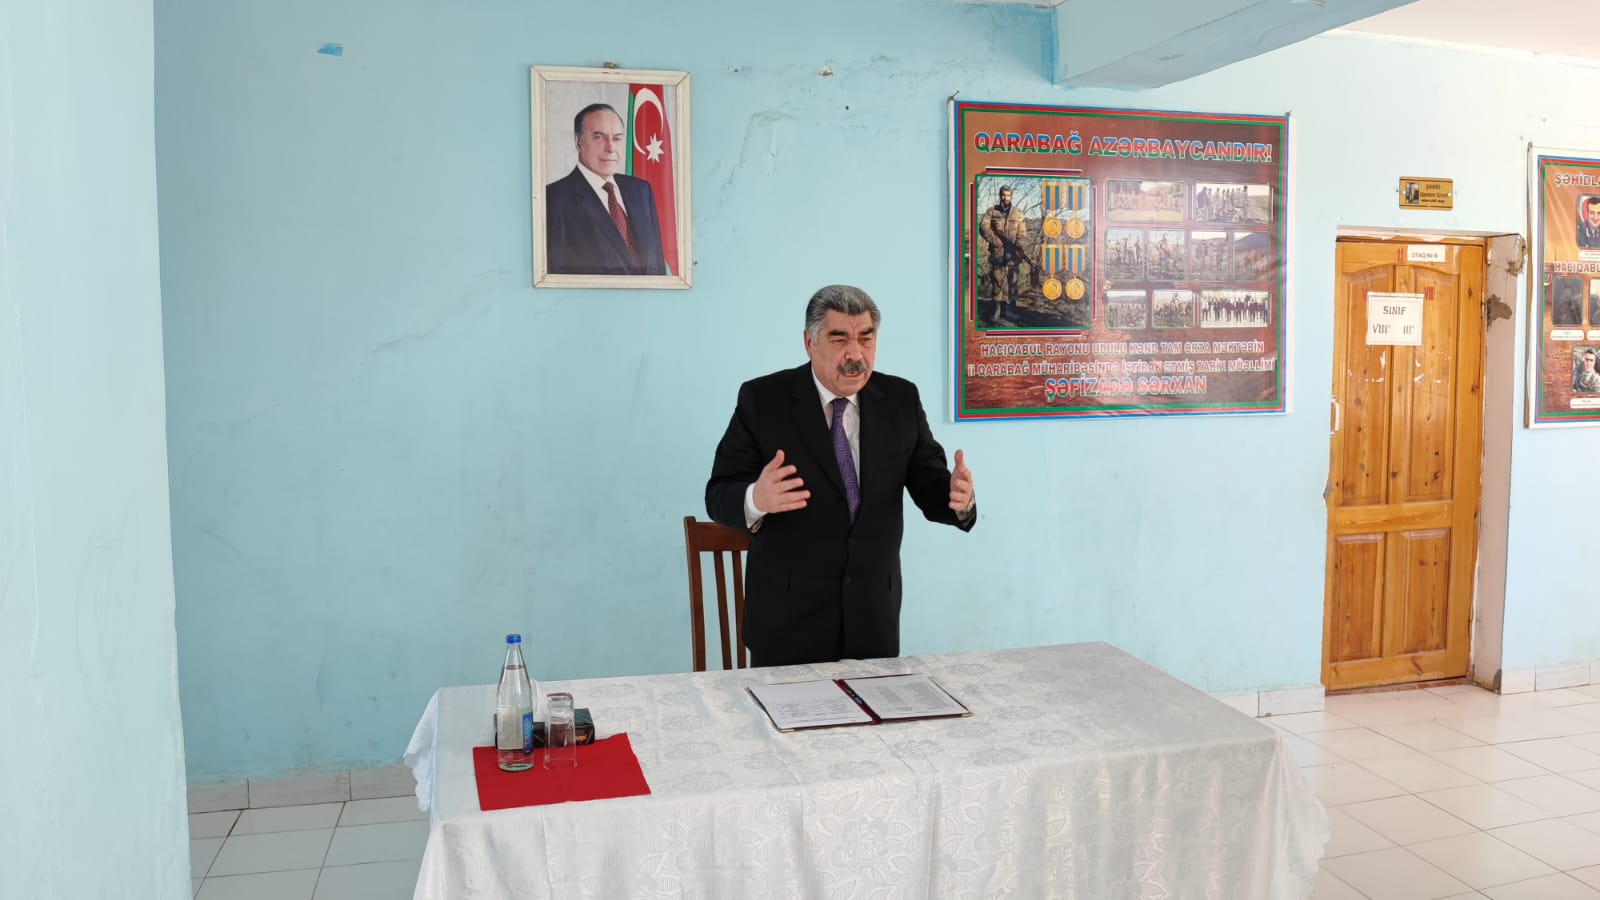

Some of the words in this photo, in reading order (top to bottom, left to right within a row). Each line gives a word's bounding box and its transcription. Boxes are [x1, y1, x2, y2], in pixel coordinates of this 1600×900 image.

[974, 131, 1082, 155] QARABAĞ
[1088, 136, 1273, 163] AZƏRBAYCANDIR!
[980, 343, 1043, 357] HACIQABUL
[1046, 343, 1090, 356] RAYONU
[1092, 342, 1128, 355] UDULU
[1160, 341, 1182, 354] TAM
[1184, 341, 1211, 353] ORTA
[978, 361, 1030, 377] QARABAĞ
[1044, 373, 1133, 402] ŞƏFİZADƏ
[1136, 375, 1207, 395] SƏRXAN
